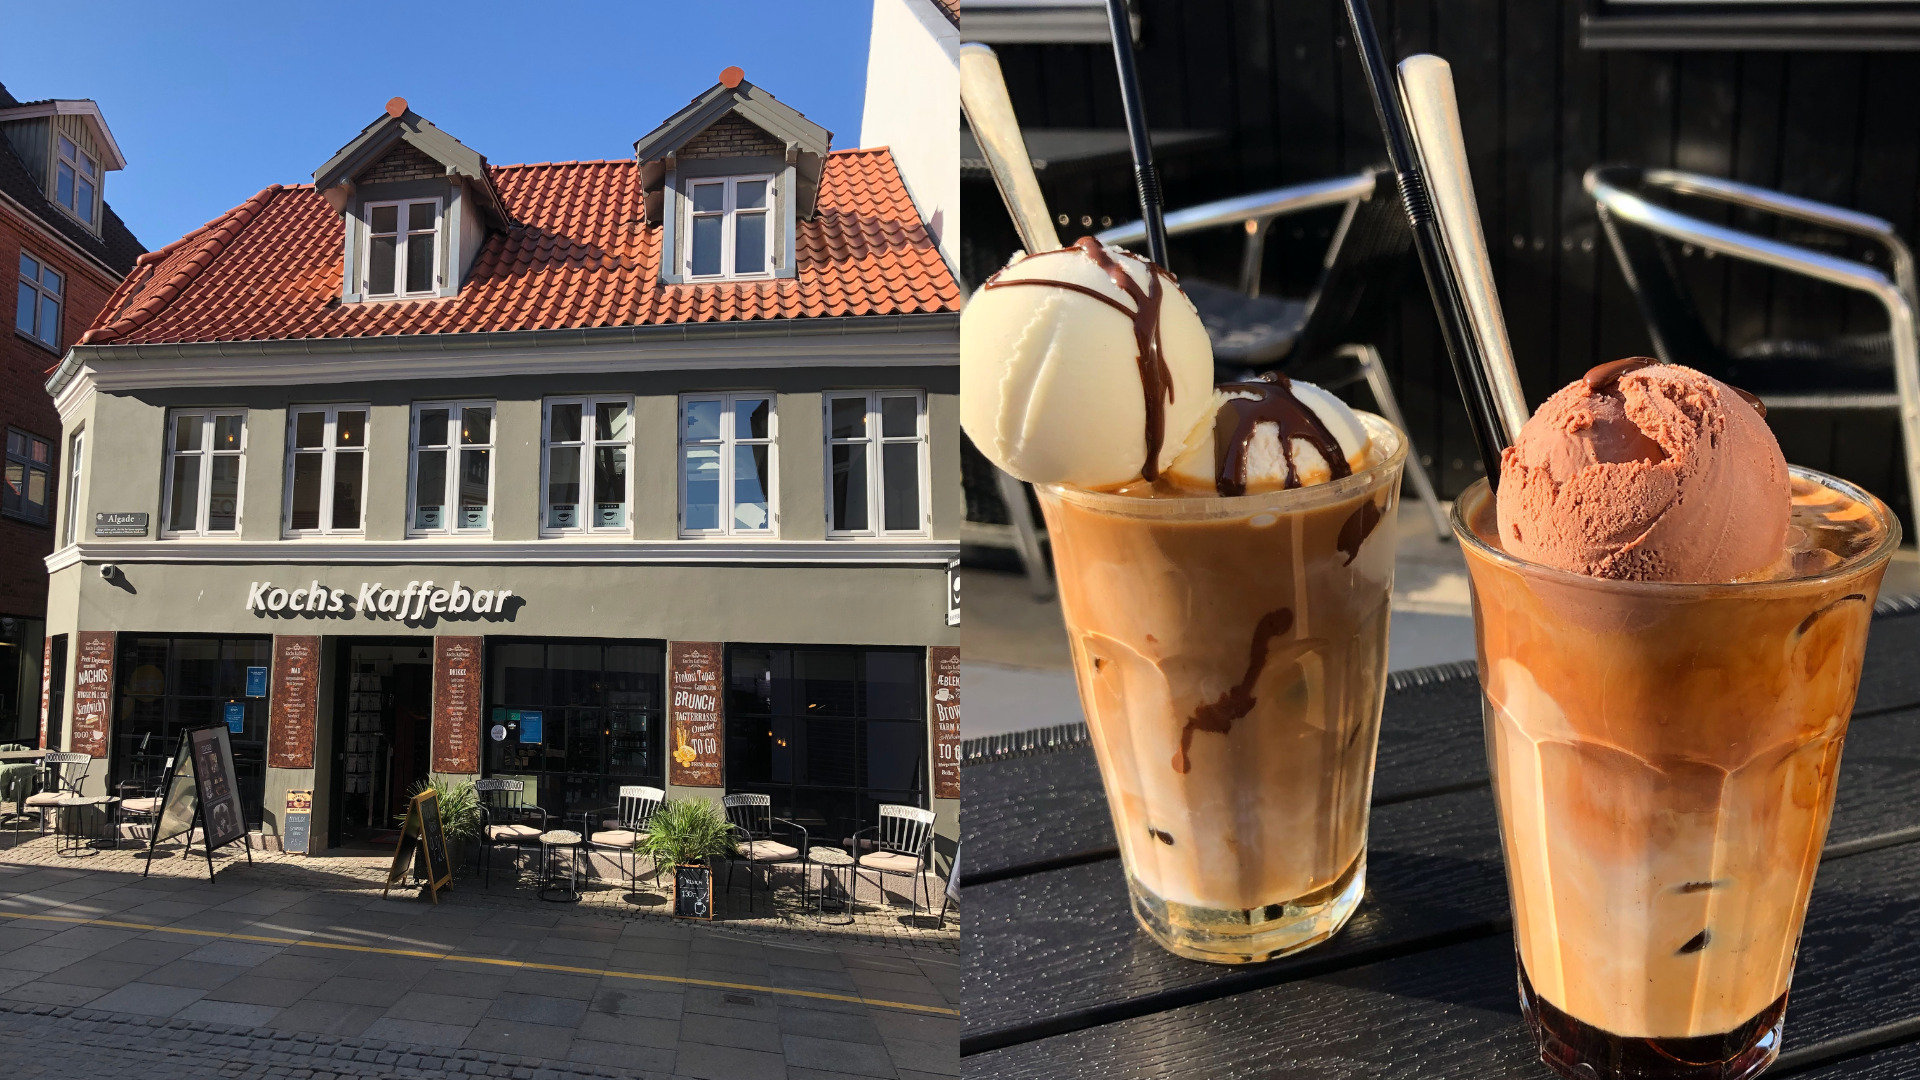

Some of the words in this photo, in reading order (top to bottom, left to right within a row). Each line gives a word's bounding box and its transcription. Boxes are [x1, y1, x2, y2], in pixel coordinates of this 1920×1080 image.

[107, 514, 135, 525] Algade
[246, 580, 345, 611] Kochs
[356, 580, 512, 620] Kaffebar
[78, 668, 108, 686] NACHOS
[674, 670, 697, 684] Frokost
[696, 669, 716, 683] Tapas
[76, 699, 103, 715] Sandwich
[674, 690, 716, 712] BRUNCH
[674, 711, 718, 722] TAGTERRASSE
[691, 722, 716, 734] Omelet
[690, 738, 704, 755] TO
[704, 738, 717, 755] GO
[938, 743, 952, 760] TO
